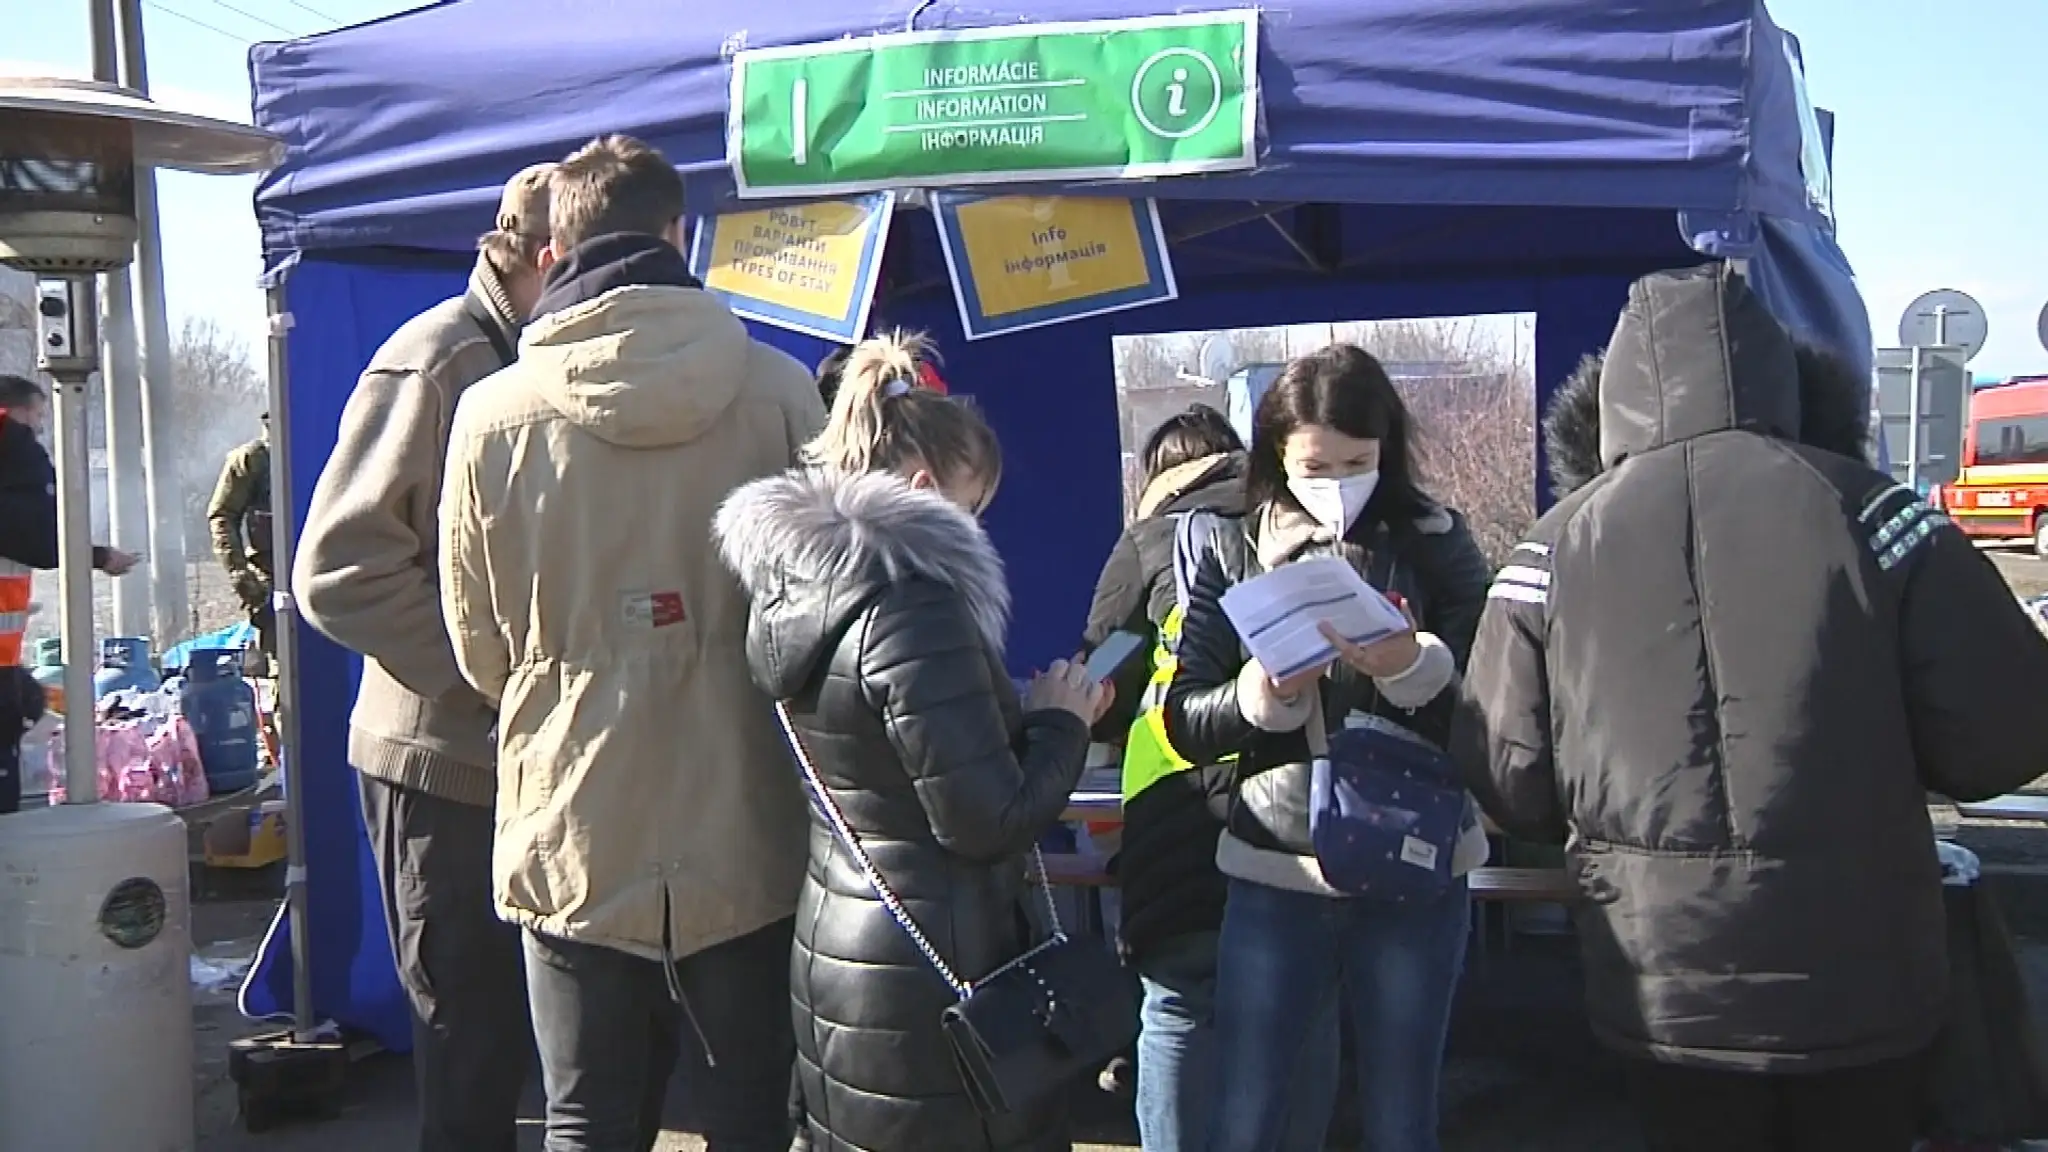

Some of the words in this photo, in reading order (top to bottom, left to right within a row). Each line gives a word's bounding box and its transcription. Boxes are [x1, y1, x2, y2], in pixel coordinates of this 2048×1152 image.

[923, 59, 1040, 87] INFORMÁCIE
[916, 93, 1047, 121] INFORMATION
[921, 125, 1044, 151] ІНФОРМАЦІЯ
[752, 224, 827, 253] ВАРІАНТИ
[1031, 225, 1067, 246] Info
[733, 238, 838, 276] ПРОЖИВАННЯ
[1004, 241, 1107, 274] інформація
[732, 257, 774, 279] TYPES
[777, 270, 797, 285] OF
[799, 275, 833, 293] STAY
